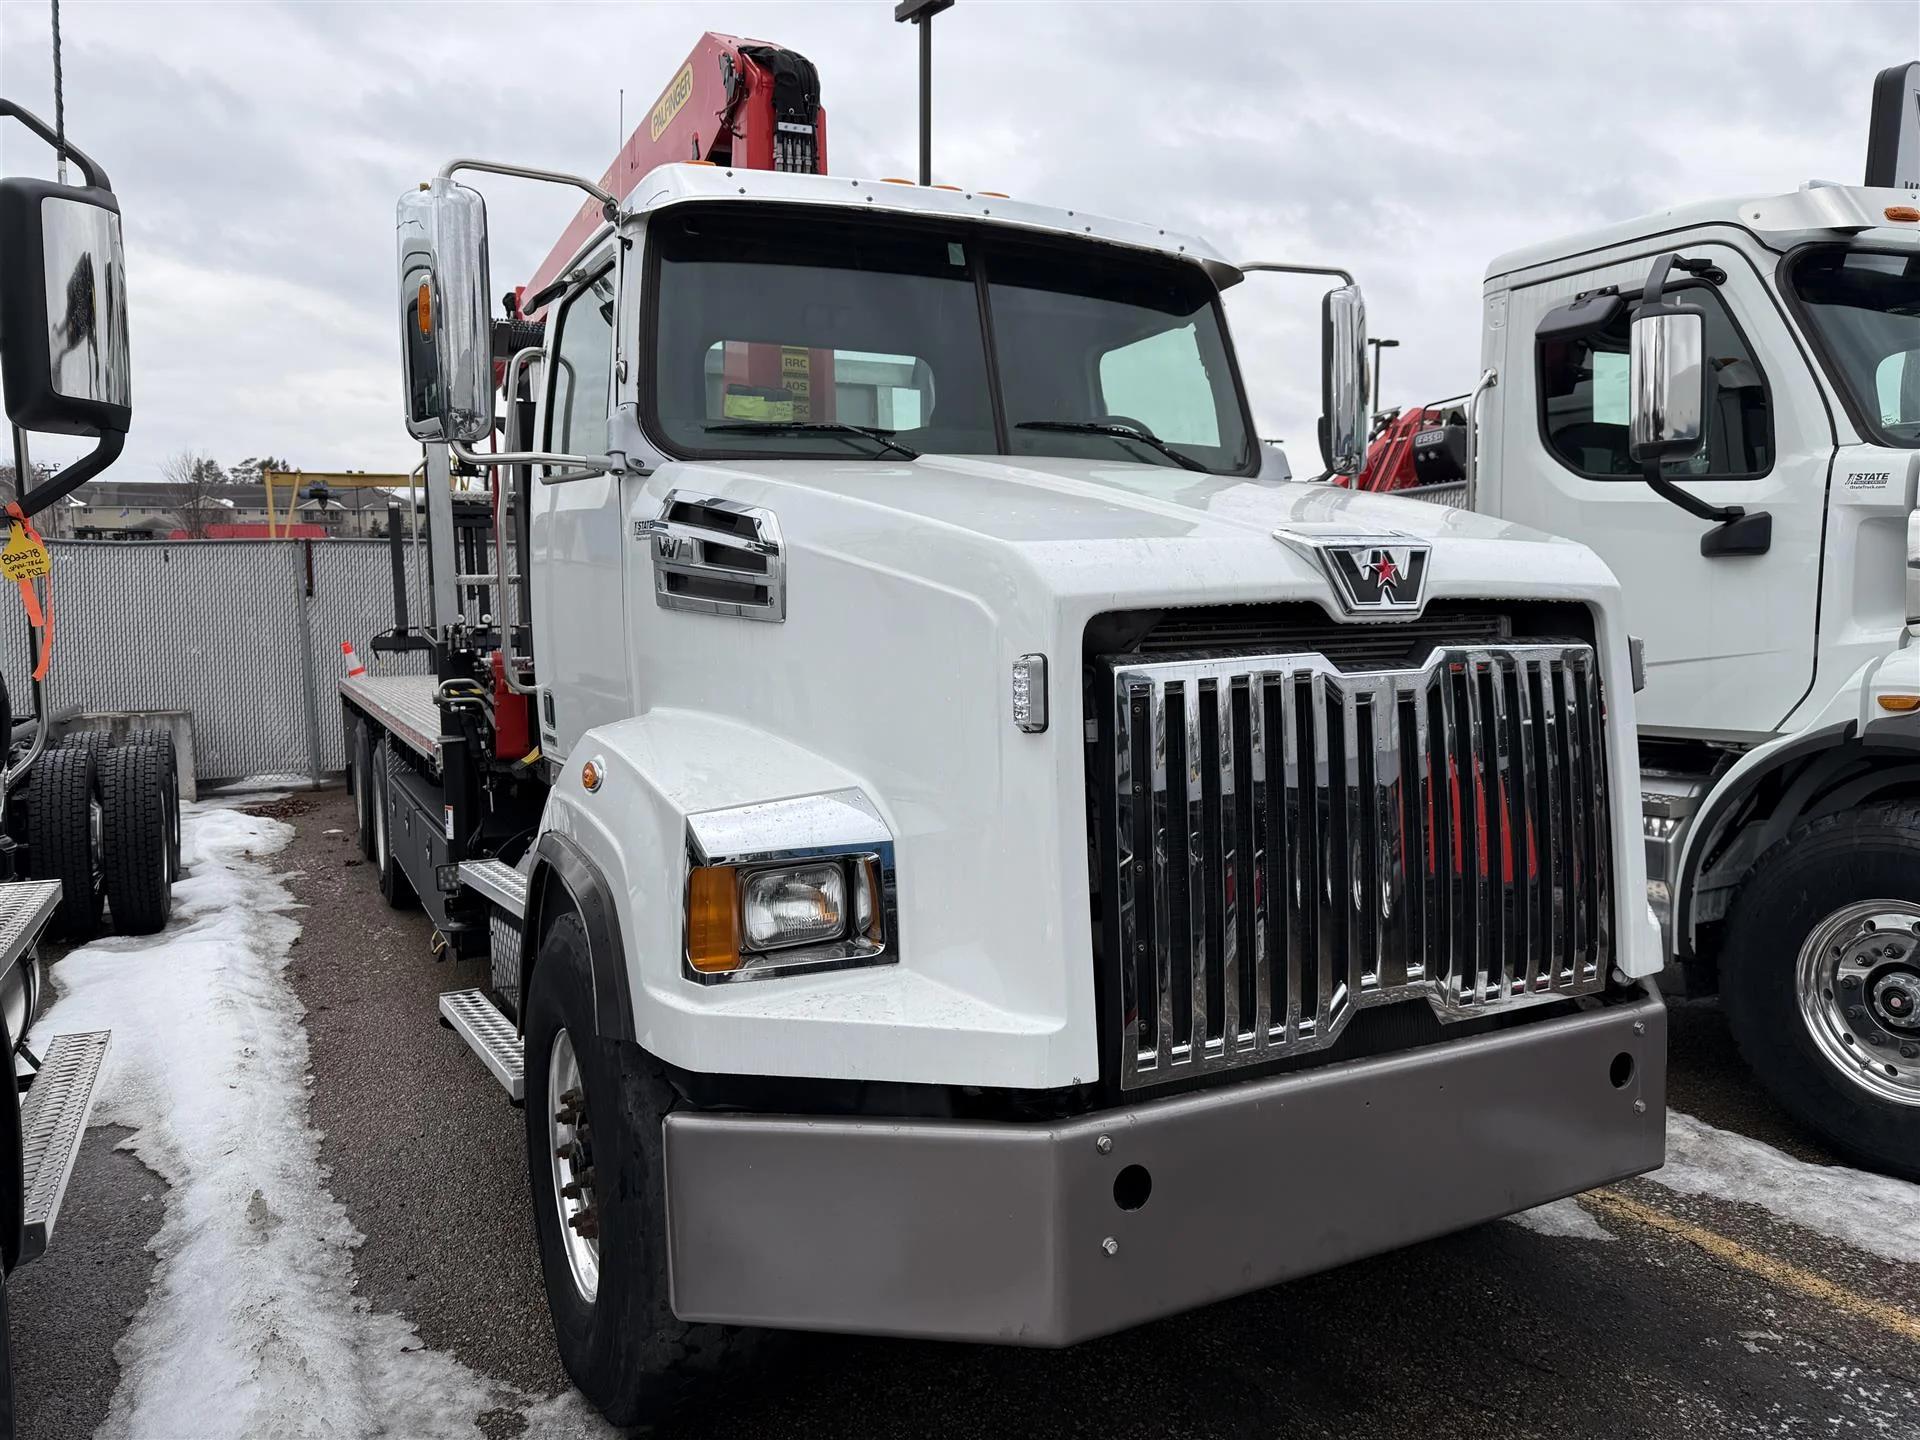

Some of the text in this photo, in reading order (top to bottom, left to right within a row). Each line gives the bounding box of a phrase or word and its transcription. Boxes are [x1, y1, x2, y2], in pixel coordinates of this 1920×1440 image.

[653, 70, 691, 137] PALFINGER
[785, 358, 807, 369] RRC
[785, 381, 807, 391] AOS
[1, 548, 41, 565] 802278
[15, 571, 26, 581] No
